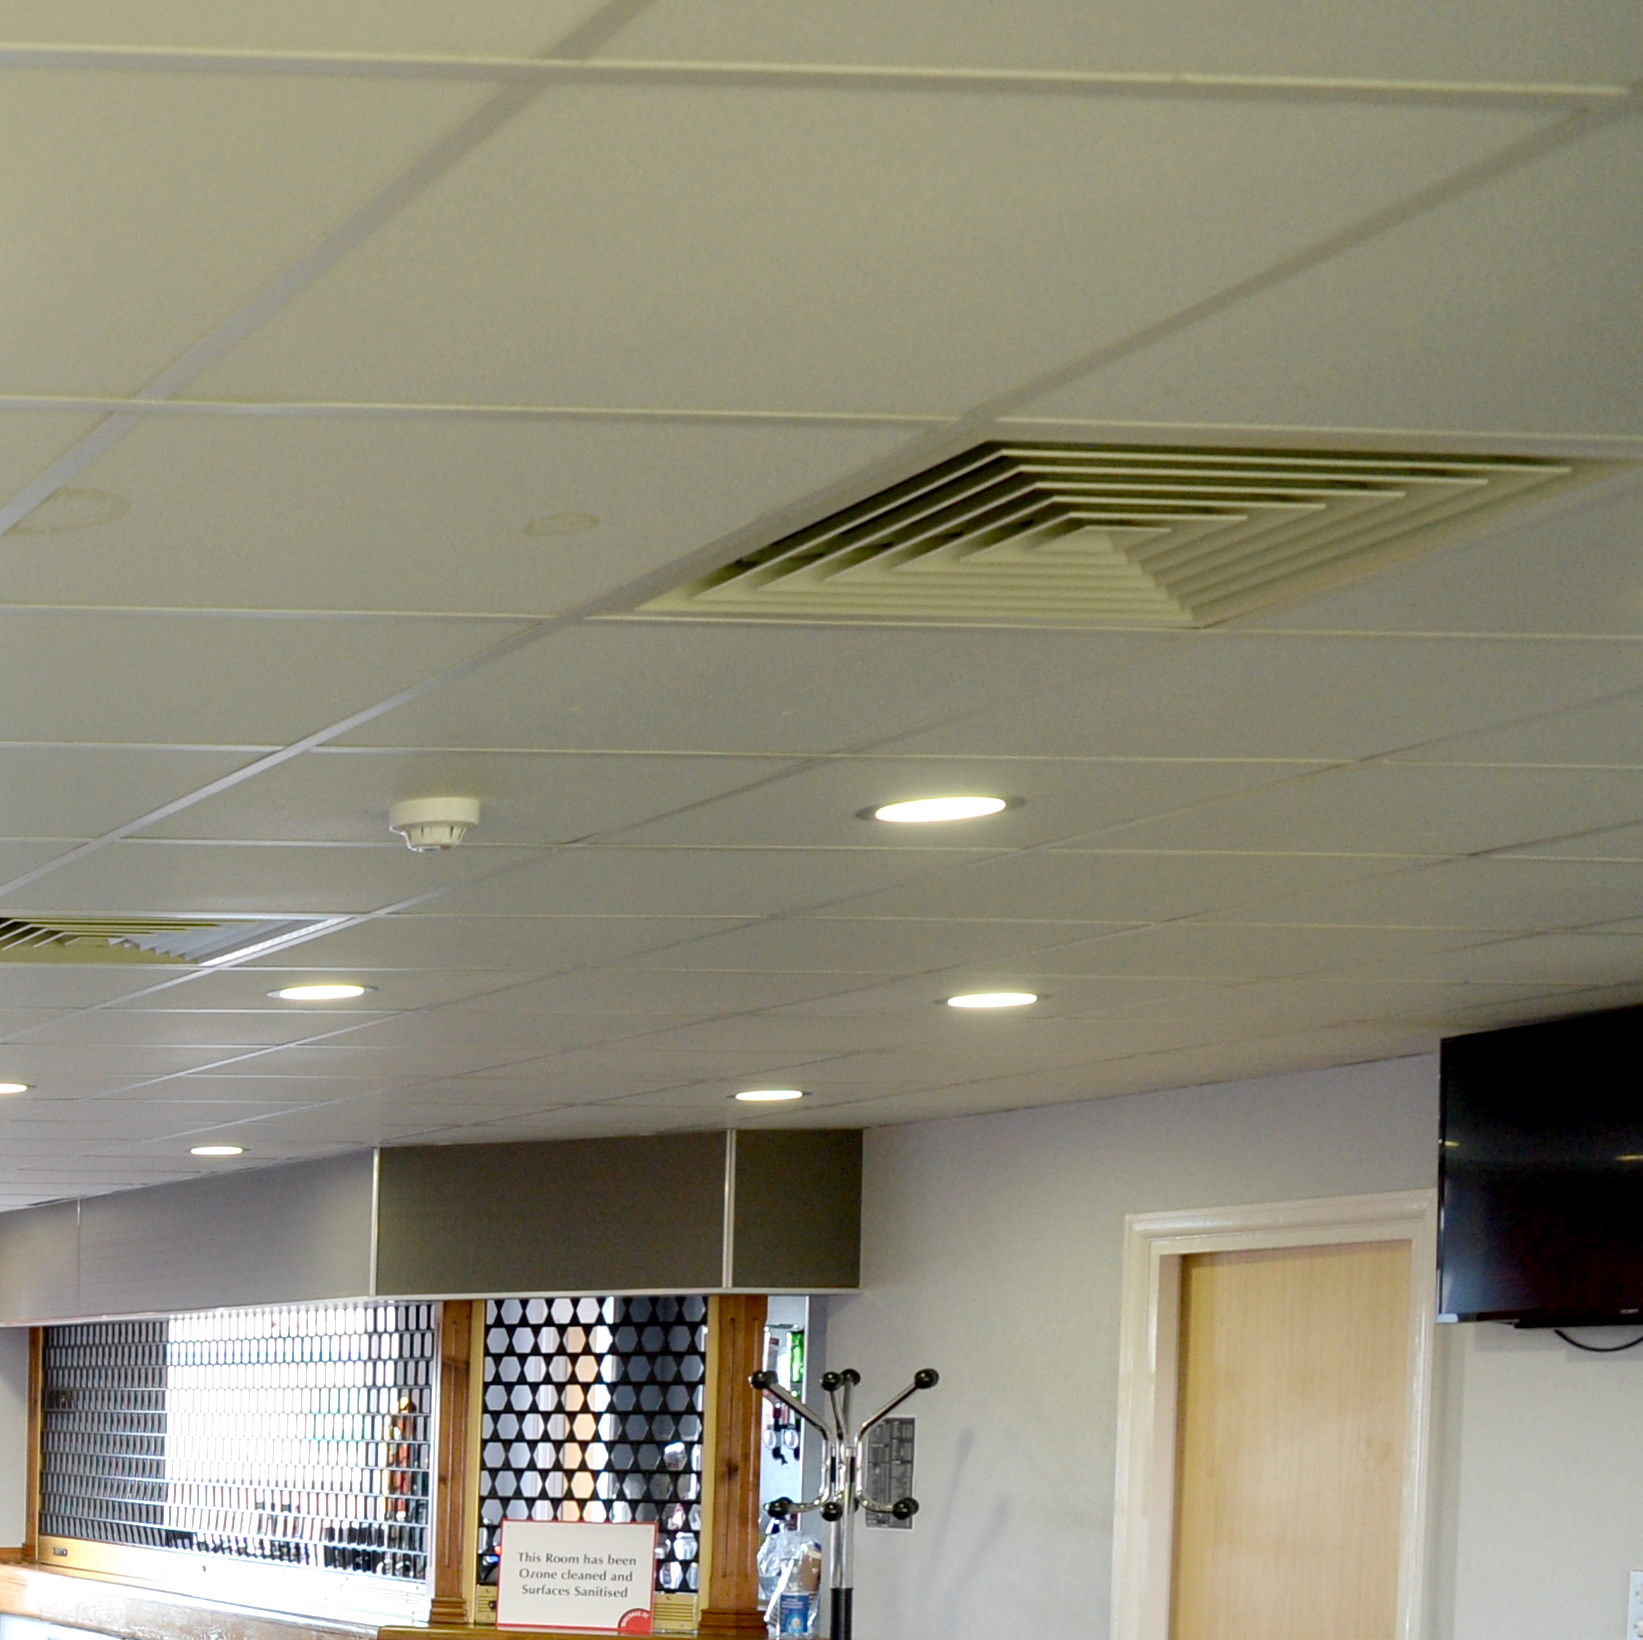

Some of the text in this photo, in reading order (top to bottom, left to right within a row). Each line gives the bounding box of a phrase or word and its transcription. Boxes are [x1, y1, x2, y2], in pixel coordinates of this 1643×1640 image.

[517, 1552, 636, 1566] This Room has been
[519, 1568, 633, 1582] Ozone cleaned and
[521, 1584, 629, 1598] Surfaces Sanitised
